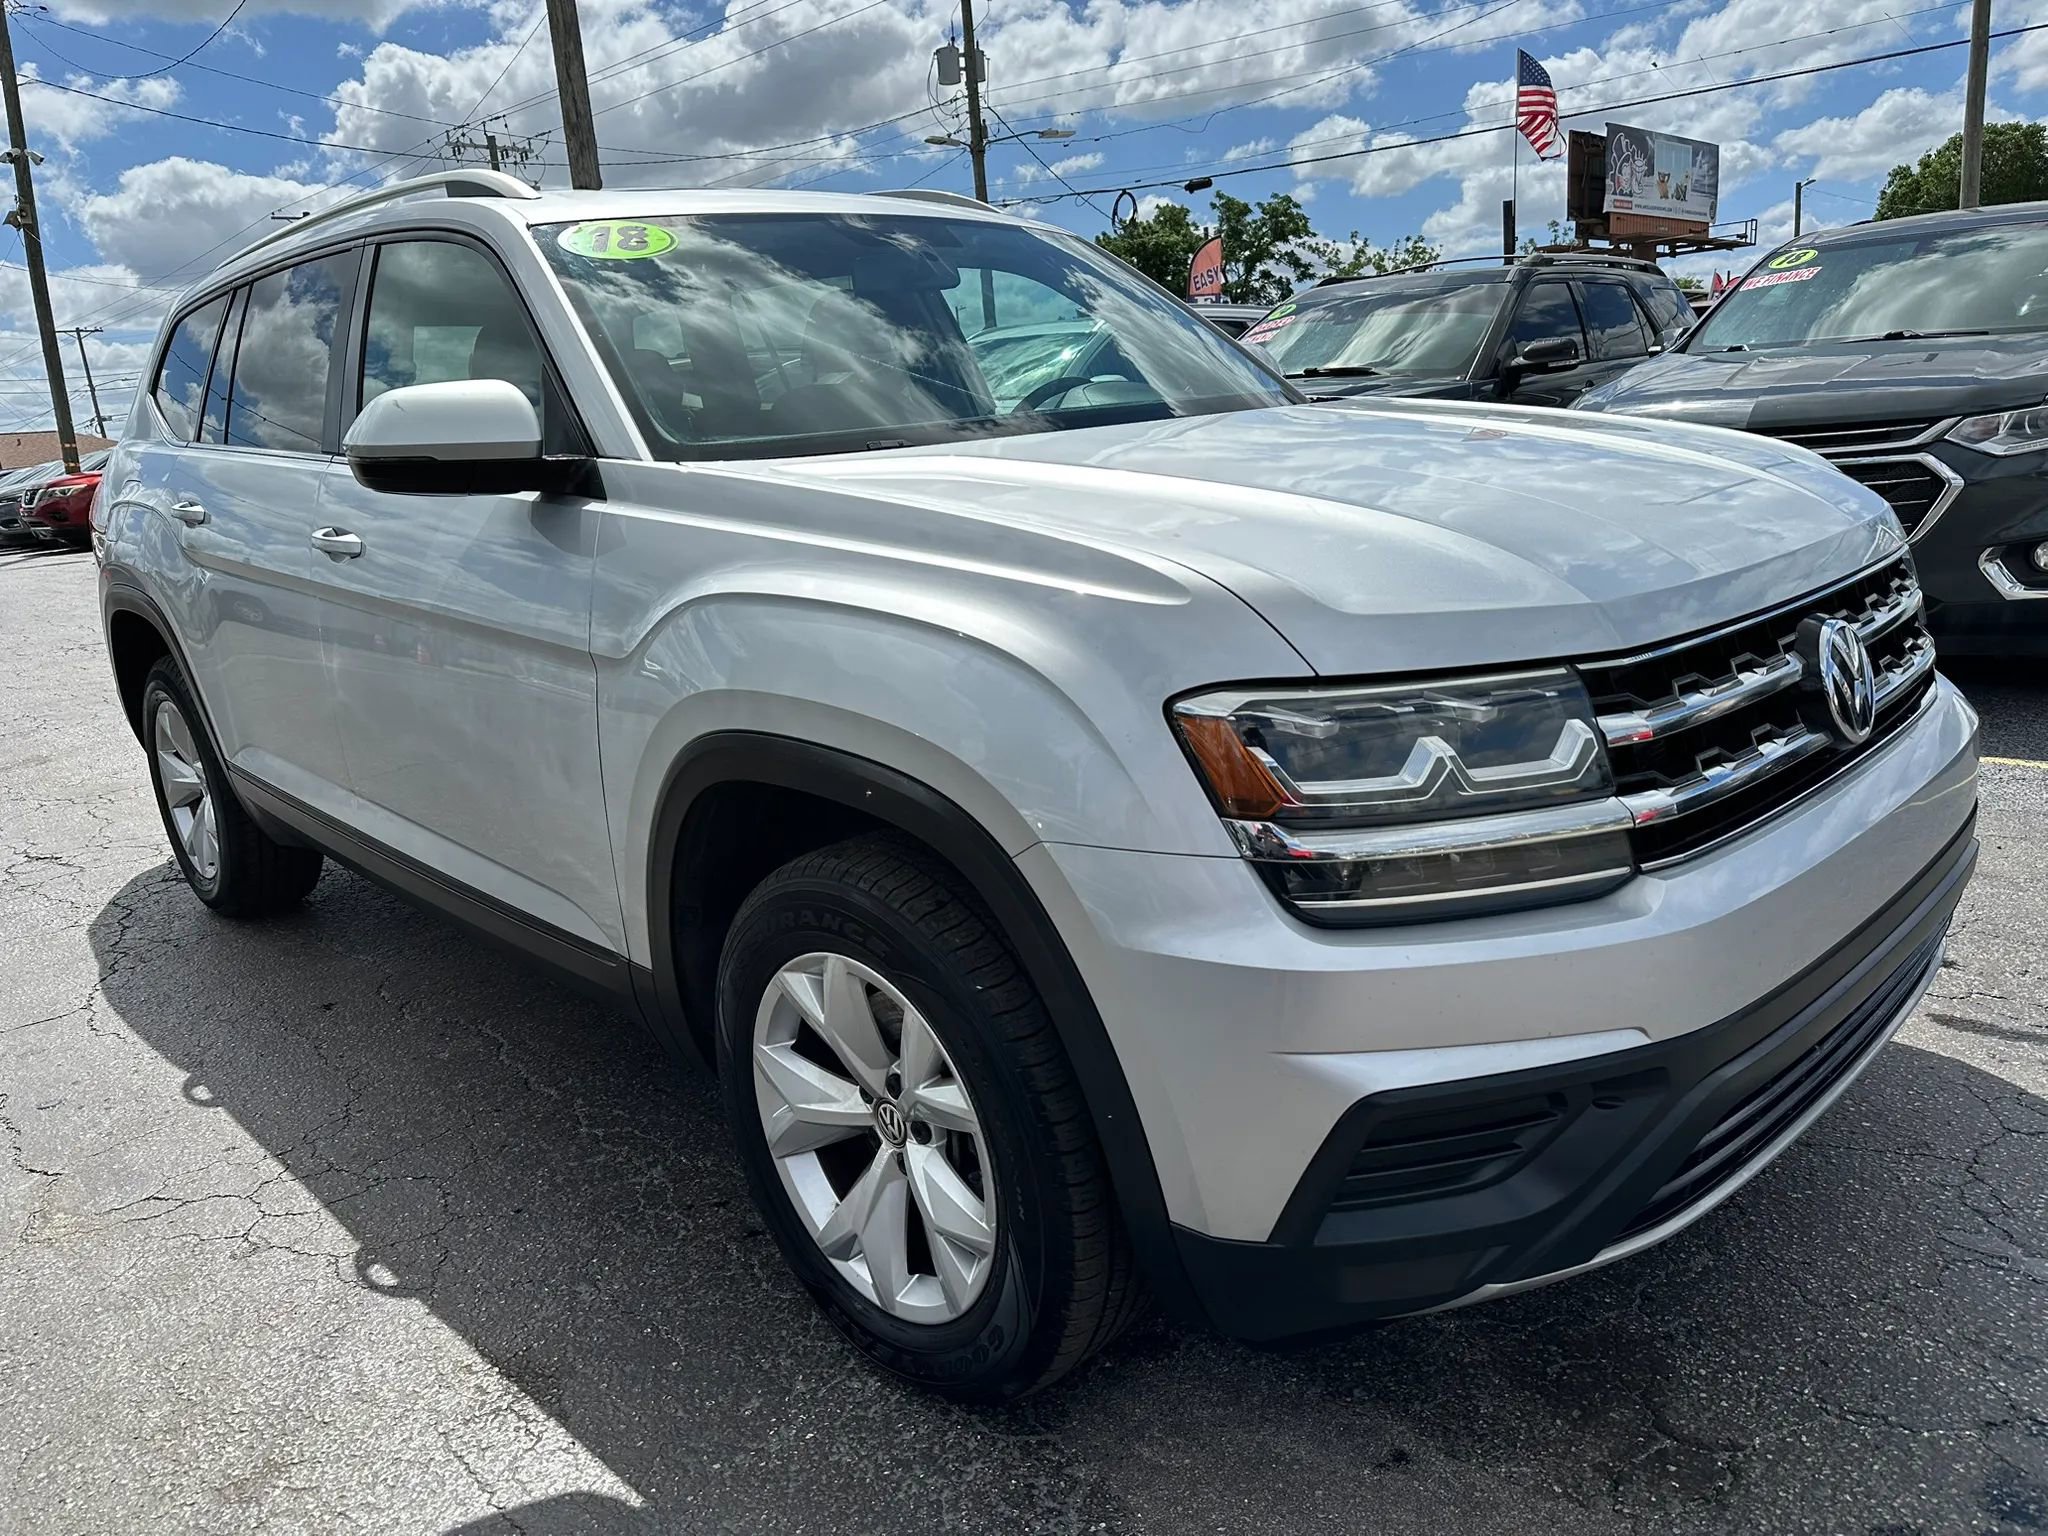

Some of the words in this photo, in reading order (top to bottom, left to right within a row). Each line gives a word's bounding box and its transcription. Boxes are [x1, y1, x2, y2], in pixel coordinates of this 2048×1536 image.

[588, 225, 650, 252] 18
[1192, 265, 1219, 292] EASY
[1761, 268, 1818, 285] FINANCE
